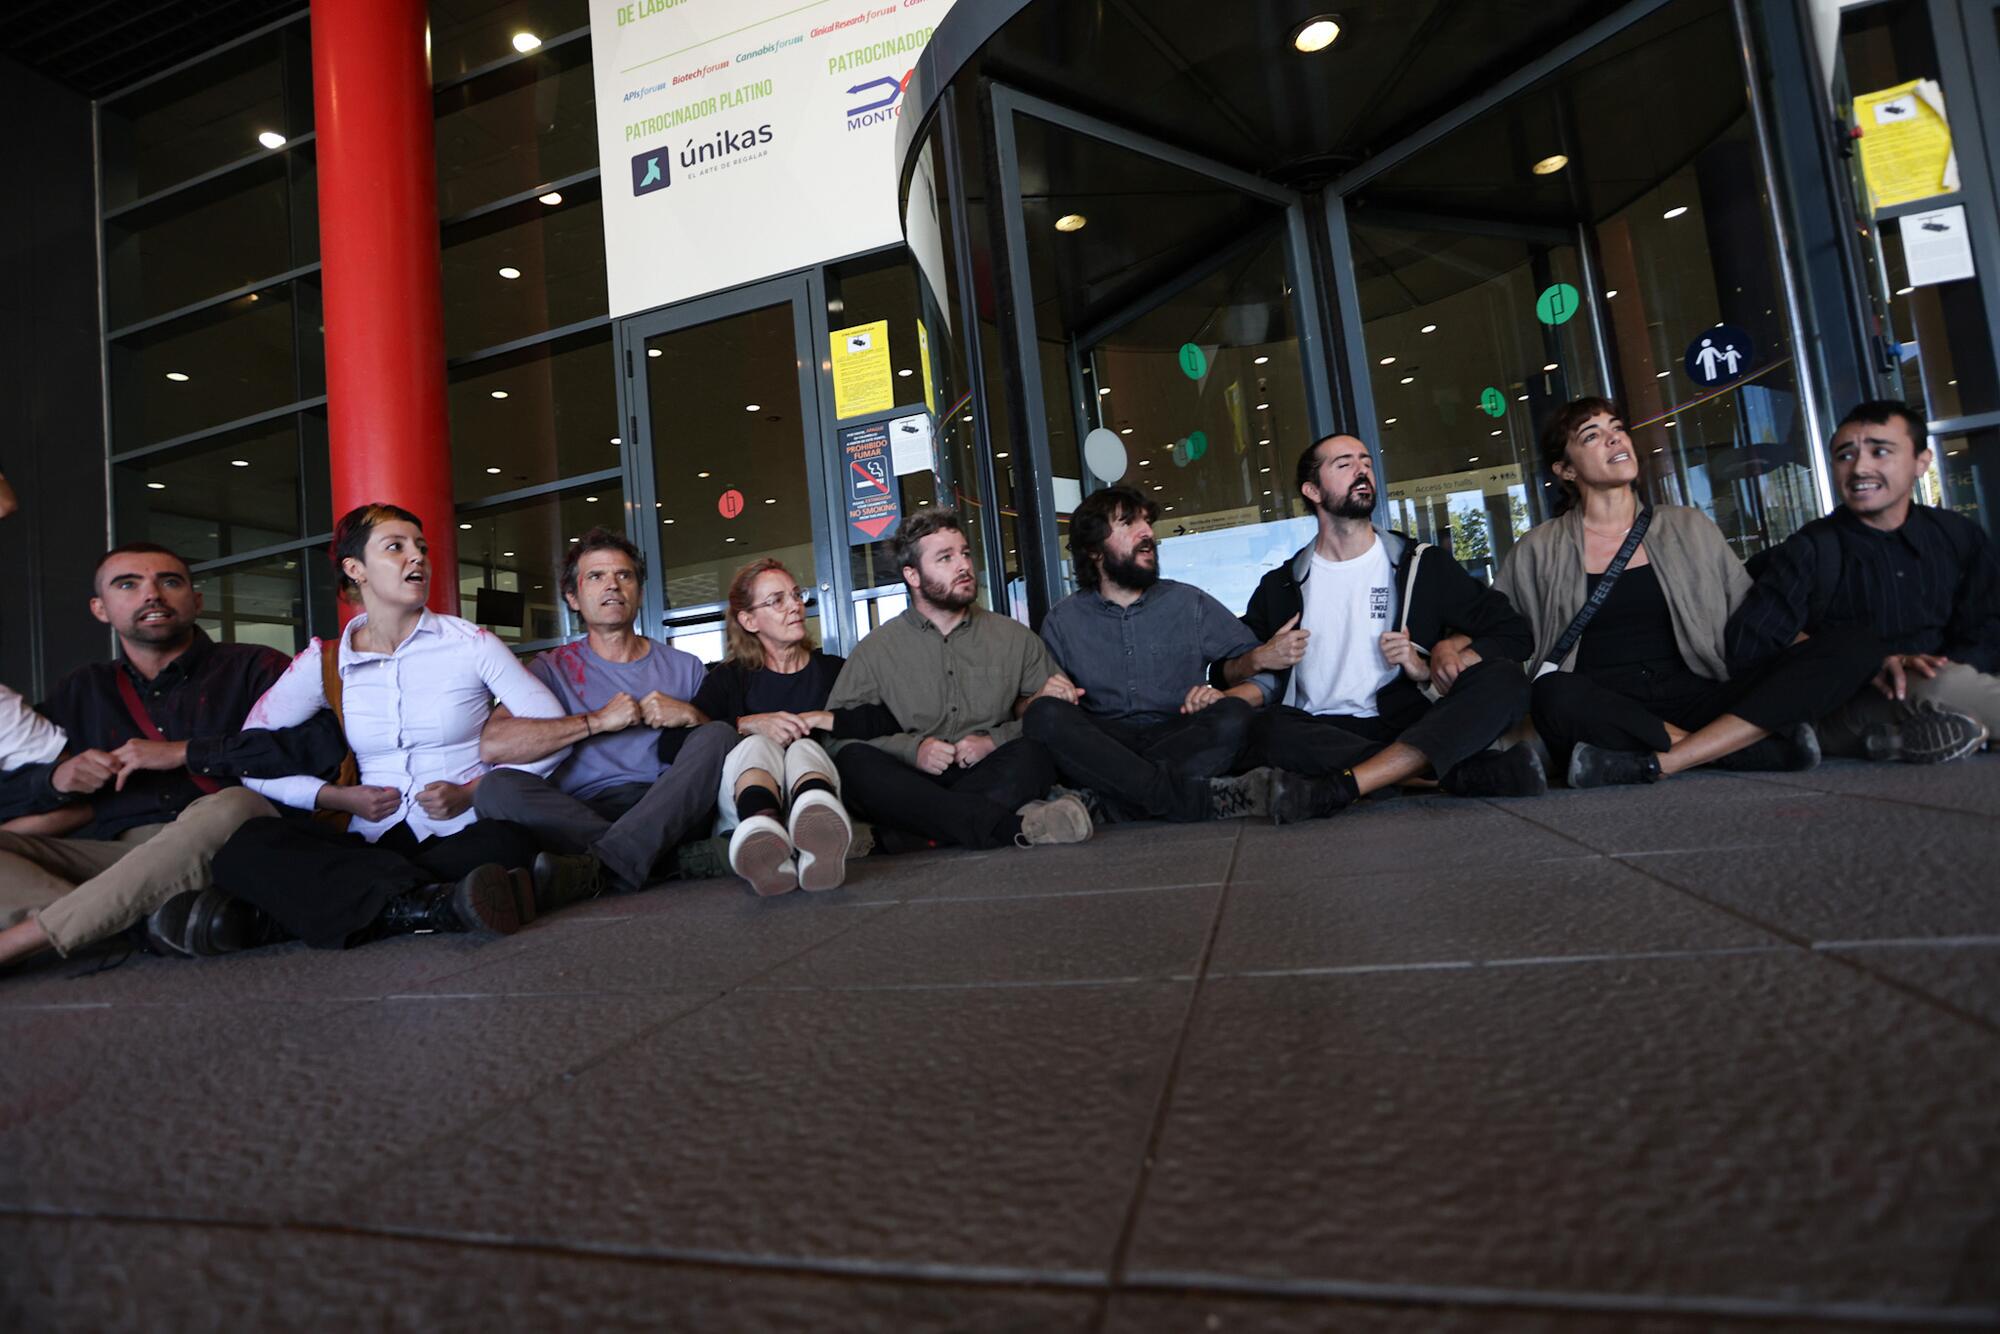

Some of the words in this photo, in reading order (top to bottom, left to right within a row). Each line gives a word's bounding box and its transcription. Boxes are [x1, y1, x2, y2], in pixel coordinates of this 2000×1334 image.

[616, 4, 635, 26] DE
[672, 60, 730, 86] Biotechforum
[735, 35, 804, 63] Cannabisforum
[810, 23, 834, 38] Clinical
[835, 14, 865, 31] Research
[625, 97, 717, 142] PATROCINADOR
[719, 78, 773, 111] PLATINO
[680, 124, 774, 168] únikas
[699, 165, 718, 176] ARTE
[720, 161, 730, 170] DE
[846, 439, 888, 454] PROHIBIDO
[854, 448, 881, 460] FUMAR
[849, 509, 861, 518] NO
[862, 502, 897, 516] SMOKING
[1591, 580, 1614, 605] FEEL
[1606, 555, 1626, 579] THE
